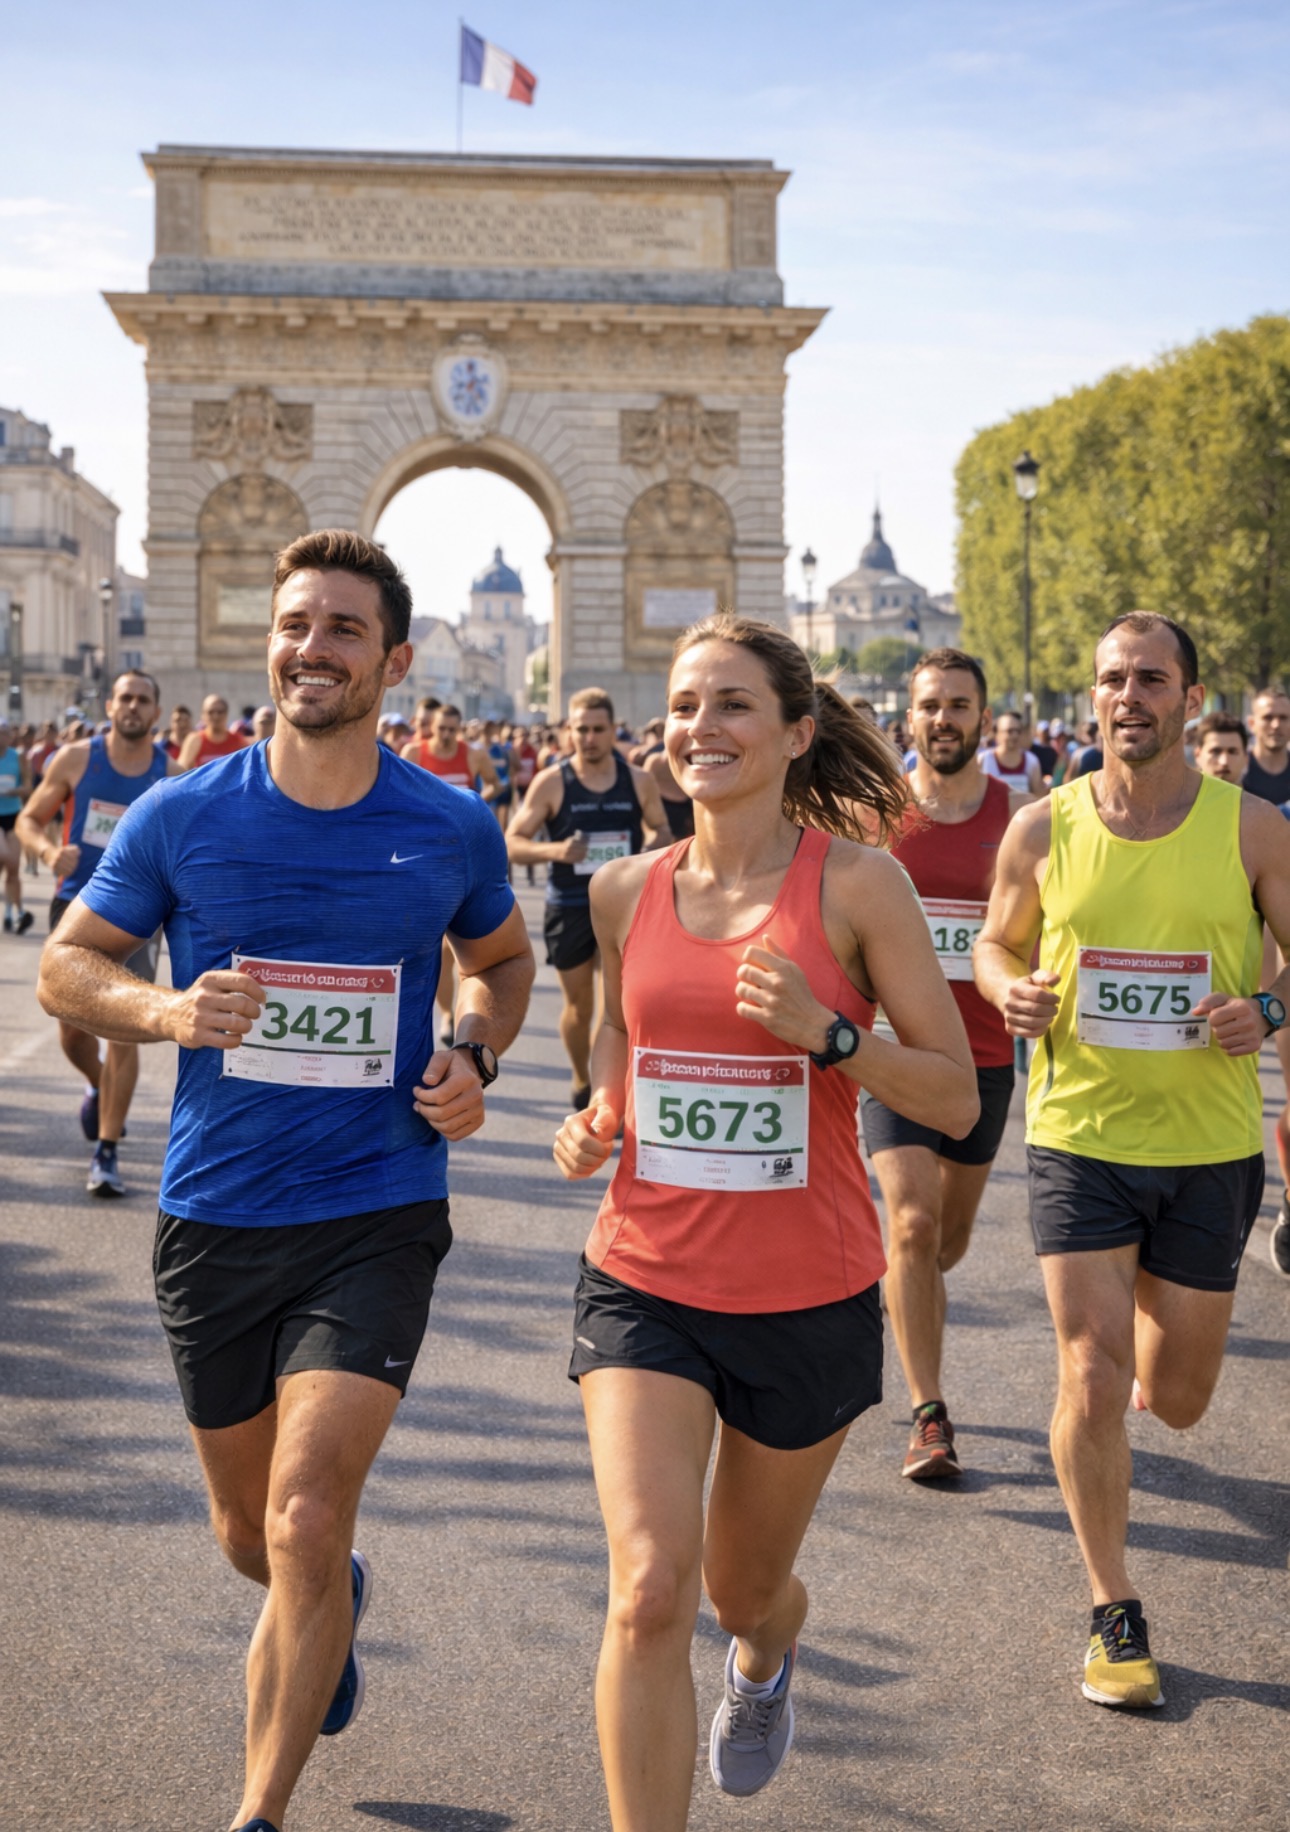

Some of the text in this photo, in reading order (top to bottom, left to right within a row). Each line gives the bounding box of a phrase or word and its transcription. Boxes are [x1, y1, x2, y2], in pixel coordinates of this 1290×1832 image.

[1098, 981, 1191, 1016] 5675
[261, 1001, 376, 1044] 3421
[658, 1095, 783, 1143] 5673
